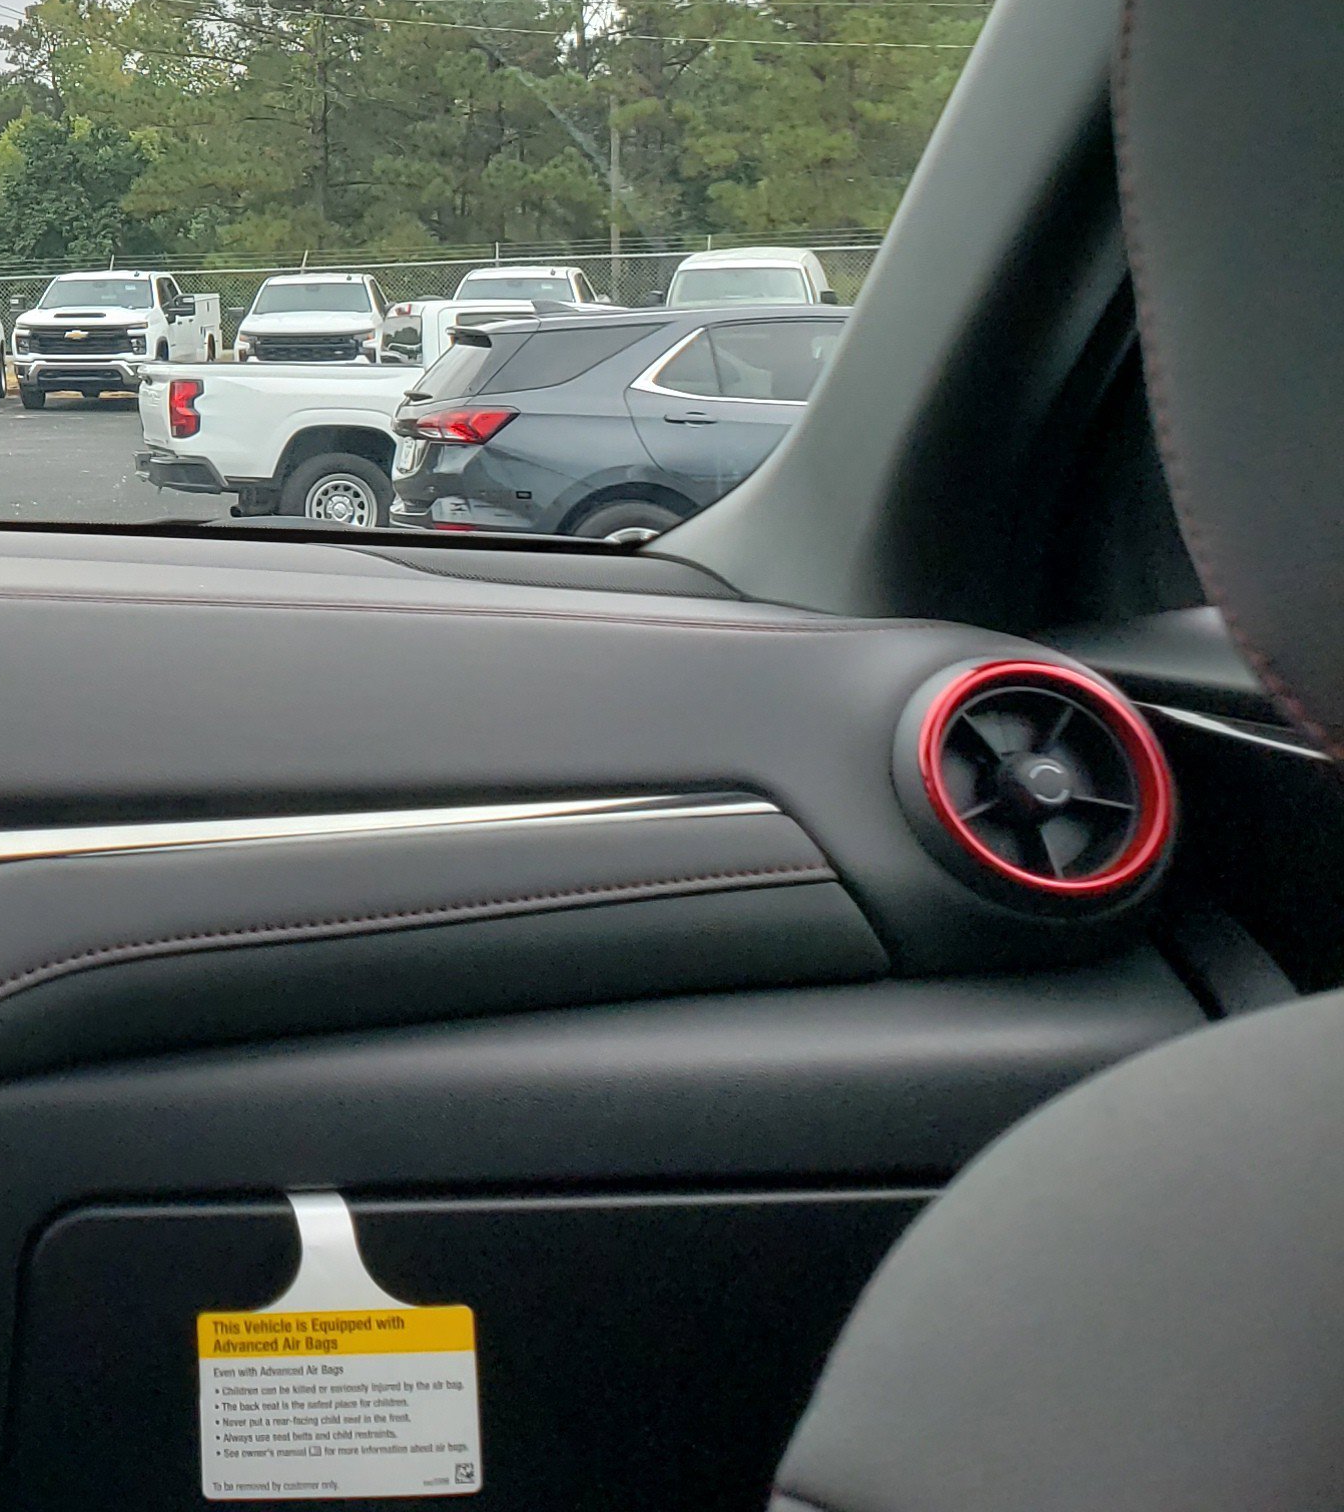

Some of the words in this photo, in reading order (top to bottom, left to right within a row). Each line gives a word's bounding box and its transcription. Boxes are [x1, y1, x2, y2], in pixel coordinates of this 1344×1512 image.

[213, 1321, 240, 1334] This
[244, 1319, 292, 1333] Vehicle
[296, 1319, 308, 1332] is
[311, 1316, 372, 1334] Equipped
[375, 1315, 405, 1330] with
[213, 1338, 279, 1353] Advanced
[283, 1337, 301, 1350] Air
[305, 1336, 338, 1353] Bags
[213, 1368, 236, 1377] Even
[238, 1367, 257, 1377] with
[260, 1366, 303, 1376] Advanced
[306, 1365, 318, 1375] Air
[321, 1365, 344, 1376] Bags
[222, 1387, 258, 1396] Children
[261, 1387, 276, 1395] can
[279, 1386, 290, 1394] be
[292, 1385, 316, 1394] killed
[319, 1385, 328, 1393] or
[403, 1381, 414, 1392] by
[416, 1380, 430, 1390] the
[432, 1380, 443, 1390] air
[222, 1402, 237, 1411] The
[240, 1401, 260, 1411] back
[262, 1402, 280, 1410] seat
[281, 1401, 290, 1409] is
[292, 1401, 305, 1409] the
[334, 1399, 357, 1409] place
[359, 1398, 371, 1408] for
[222, 1418, 247, 1427] Never
[249, 1417, 263, 1427] put
[273, 1416, 318, 1426] rear-facing
[320, 1414, 341, 1425] child
[343, 1415, 361, 1424] seat
[364, 1414, 372, 1423] in
[374, 1413, 387, 1423] the
[223, 1433, 252, 1443] Always
[255, 1433, 270, 1442] use
[273, 1432, 291, 1441] seat
[293, 1431, 313, 1441] belts
[315, 1431, 330, 1440] and
[332, 1430, 353, 1440] child
[223, 1449, 240, 1458] See
[241, 1449, 274, 1457] owner's
[276, 1447, 306, 1457] manual
[324, 1446, 335, 1456] for
[338, 1446, 359, 1455] more
[361, 1444, 408, 1454] information
[410, 1443, 433, 1453] about
[213, 1482, 222, 1491] To
[224, 1482, 234, 1491] be
[236, 1481, 270, 1491] removed
[272, 1481, 281, 1492] by
[283, 1481, 319, 1490] customer
